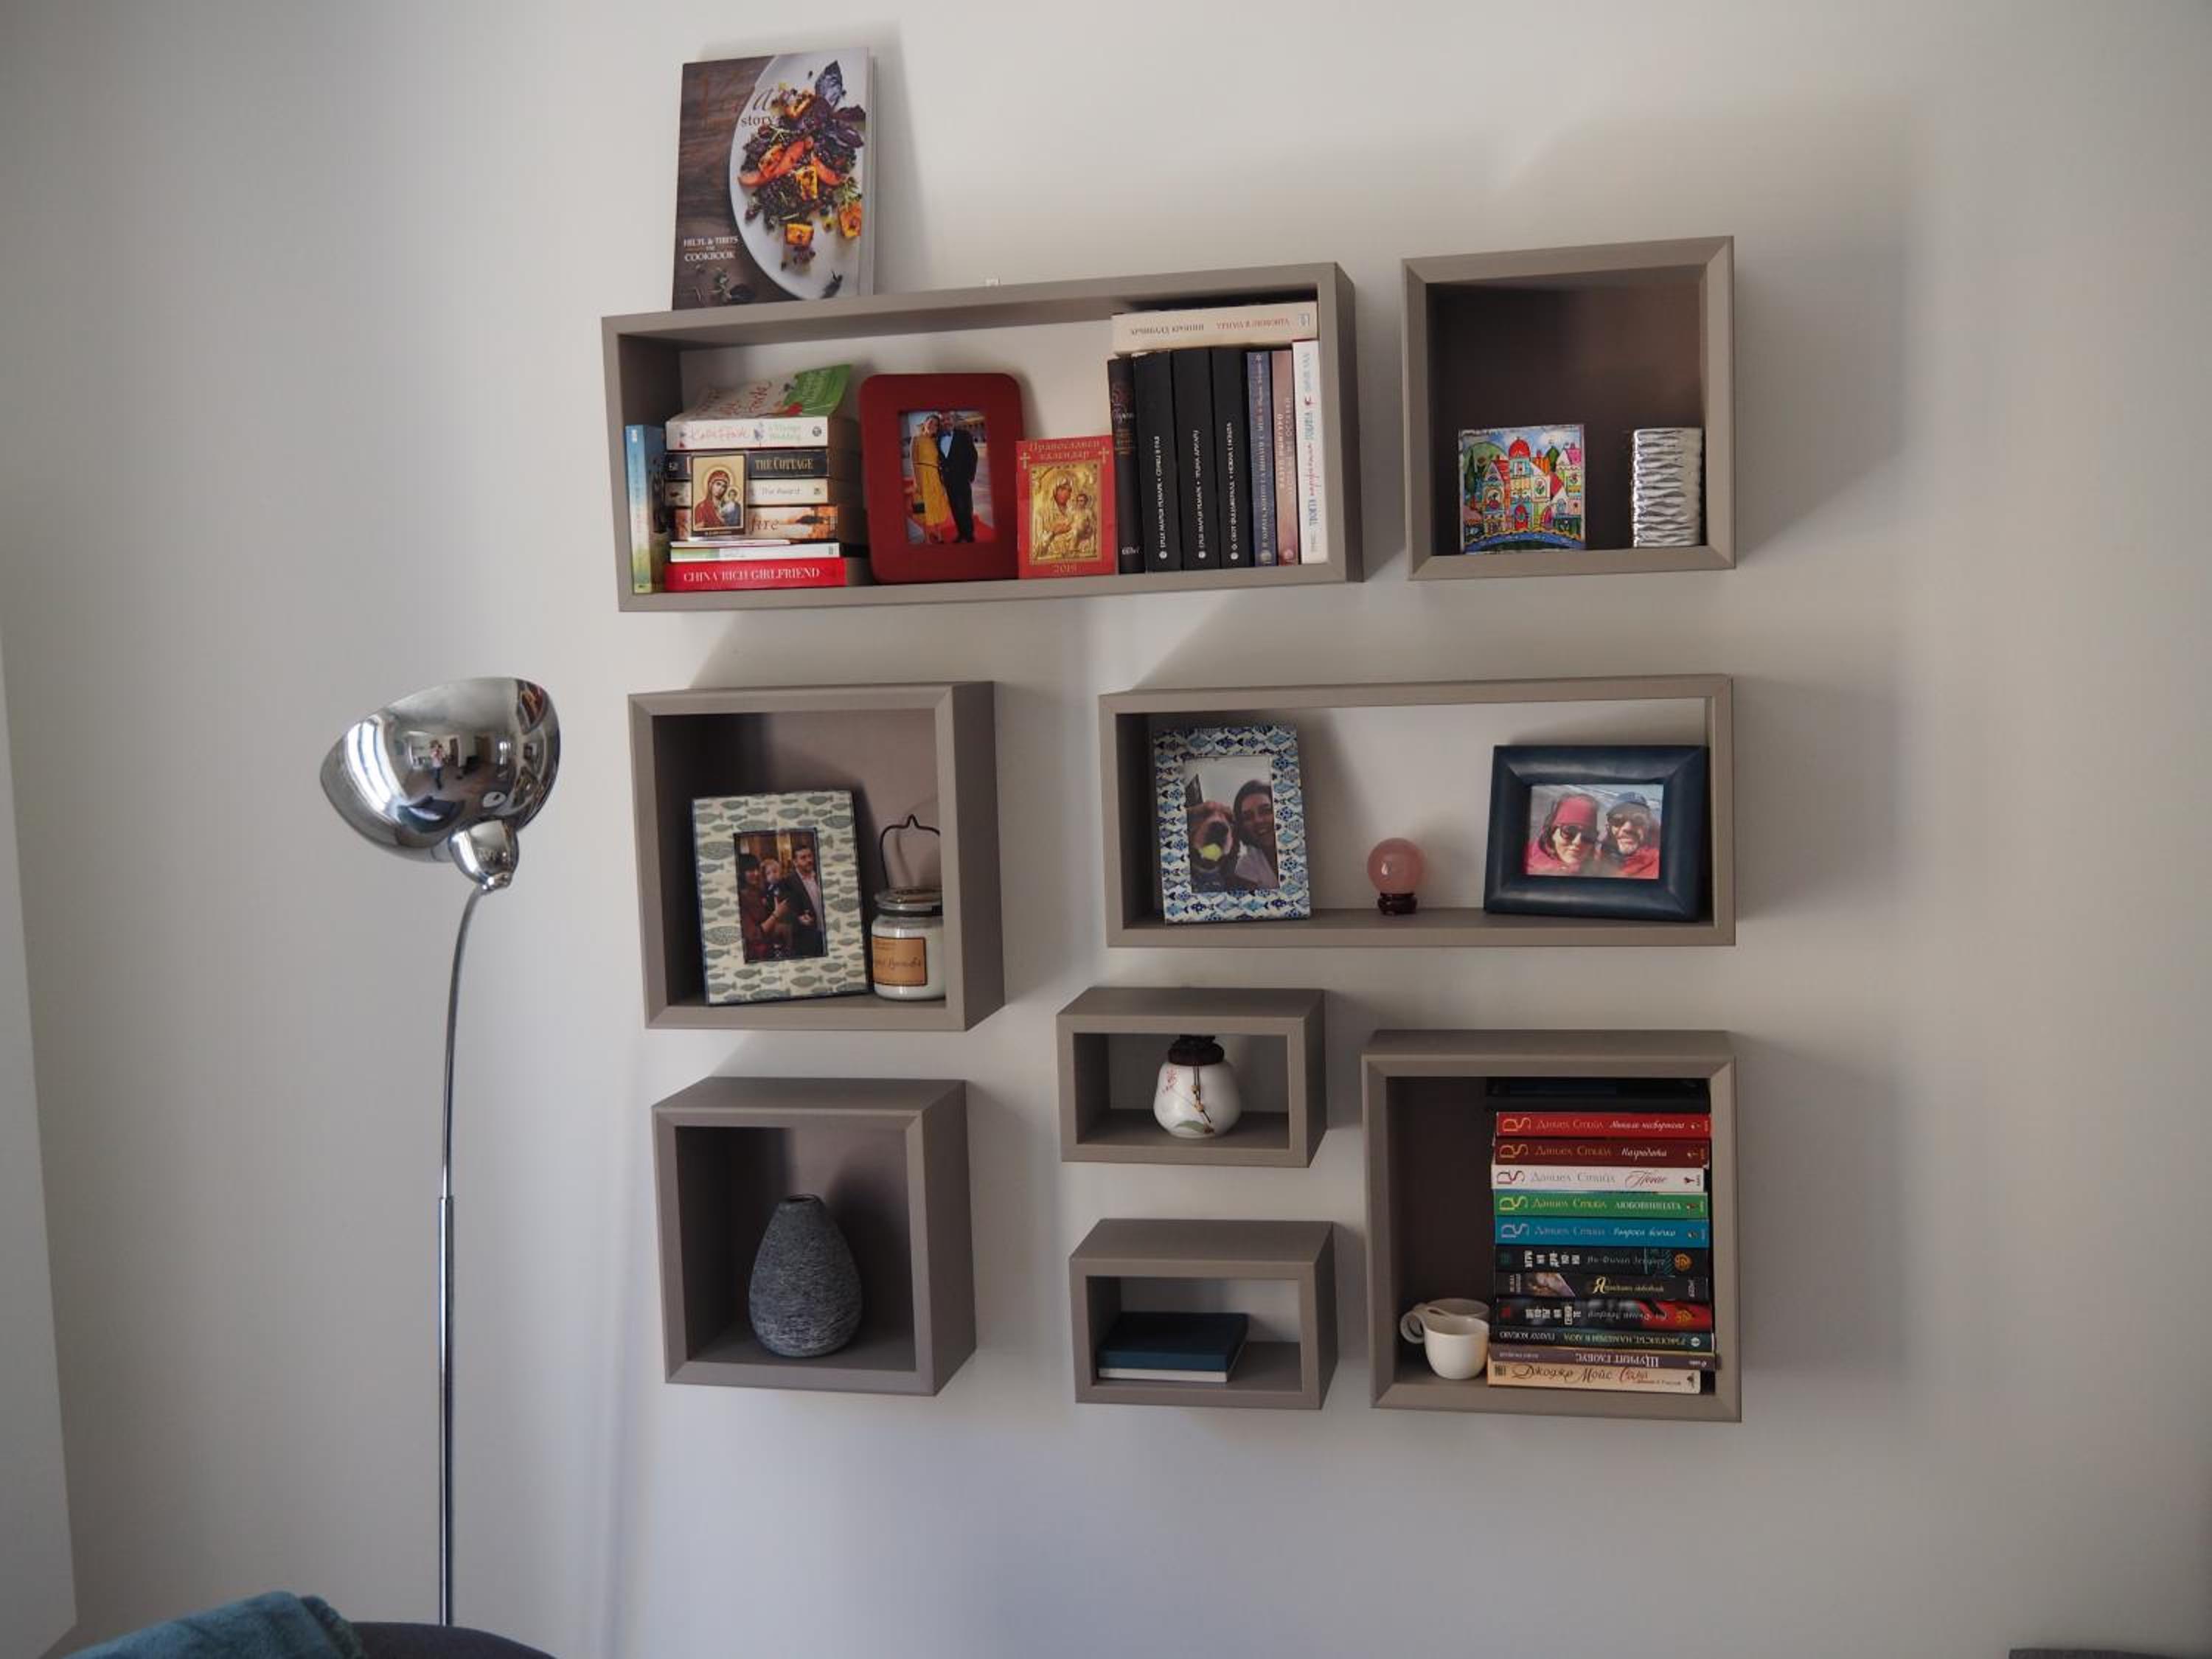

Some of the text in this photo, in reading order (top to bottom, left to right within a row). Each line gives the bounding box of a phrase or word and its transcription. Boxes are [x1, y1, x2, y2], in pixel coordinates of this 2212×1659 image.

[684, 251, 735, 262] COOKBOOK
[755, 456, 814, 470] THE COTTAGE
[684, 567, 821, 582] CHINA RICH GIRLFRIEND
[1615, 1201, 1682, 1211] ЛЮБОВНИЦАТА
